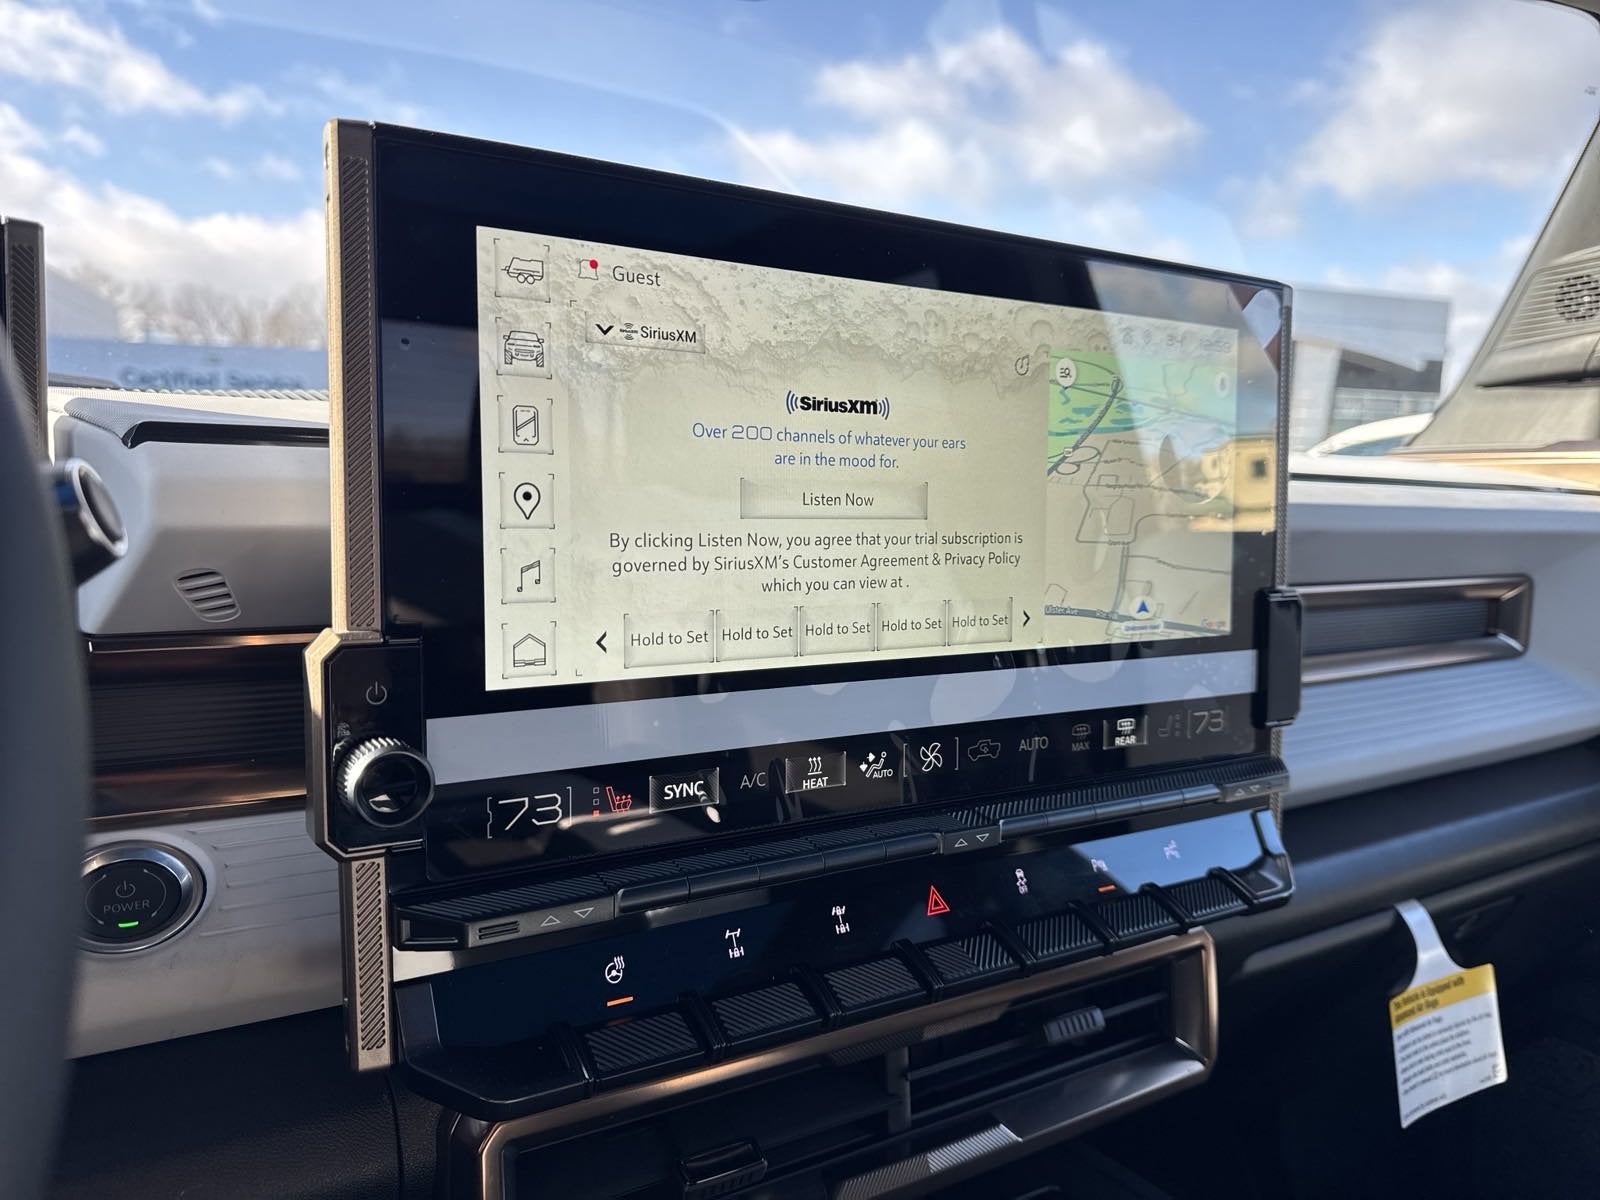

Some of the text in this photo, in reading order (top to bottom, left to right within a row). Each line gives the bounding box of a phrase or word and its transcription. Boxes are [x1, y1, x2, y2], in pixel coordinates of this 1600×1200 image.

[612, 265, 661, 287] Guest
[640, 325, 697, 344] SiriusXM
[692, 422, 966, 452] Over 200 channels of whatever your ears
[774, 451, 899, 469] are in the mood for.
[802, 491, 874, 507] Listen Now
[609, 530, 1024, 553] By clicking Listen Now, you agree that your trial subscription is
[612, 551, 1021, 578] governed by SiriusXM's Customer Agreement & Privacy Policy
[761, 576, 802, 593] which
[805, 580, 829, 596] you
[832, 579, 856, 591] can
[858, 575, 888, 590] view
[890, 575, 903, 589] at
[805, 621, 871, 637] Hold to Set
[881, 617, 943, 632] Hold to Set
[951, 614, 1009, 628] Hold to Set
[630, 630, 709, 647] Hold to Set
[722, 625, 793, 641] Hold to Set
[1192, 709, 1225, 734] 73
[1018, 736, 1049, 752] AUTO
[1071, 741, 1090, 751] MAX
[1114, 735, 1137, 746] REAR
[740, 771, 767, 789] A/C
[872, 768, 893, 779] AUTO
[663, 780, 705, 800] SYNC
[802, 776, 829, 790] HEAT
[497, 793, 563, 831] 73
[103, 899, 150, 914] POWER
